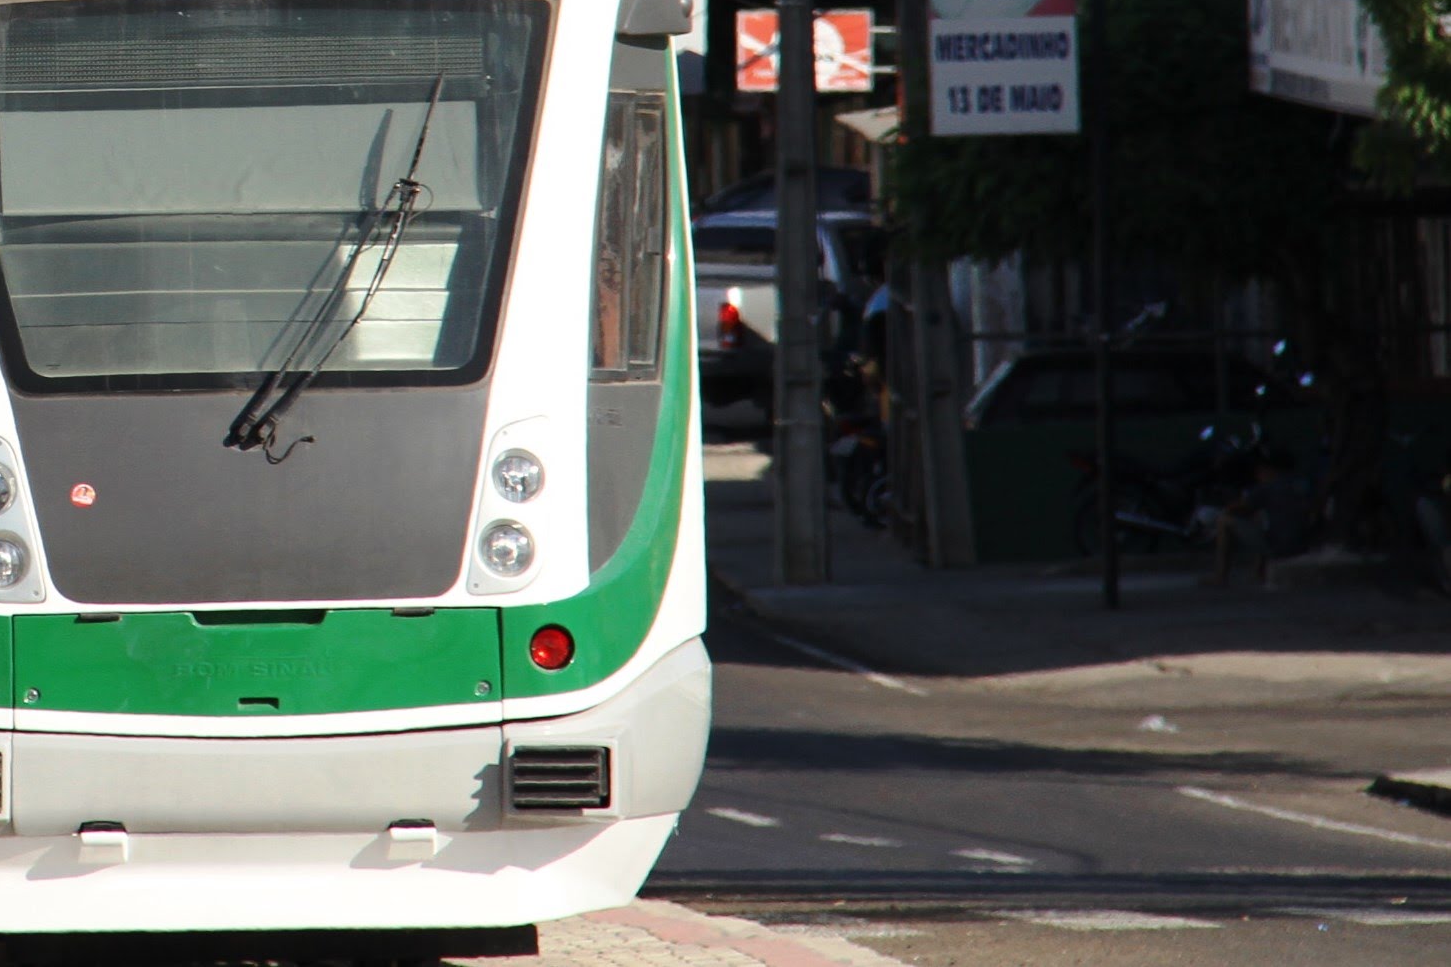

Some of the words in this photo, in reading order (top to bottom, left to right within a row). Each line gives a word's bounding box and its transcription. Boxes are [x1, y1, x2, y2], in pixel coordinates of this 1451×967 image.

[936, 32, 1068, 61] MERCADINHO
[949, 86, 970, 114] 13
[977, 85, 1004, 113] DE
[1010, 84, 1064, 112] MAIO
